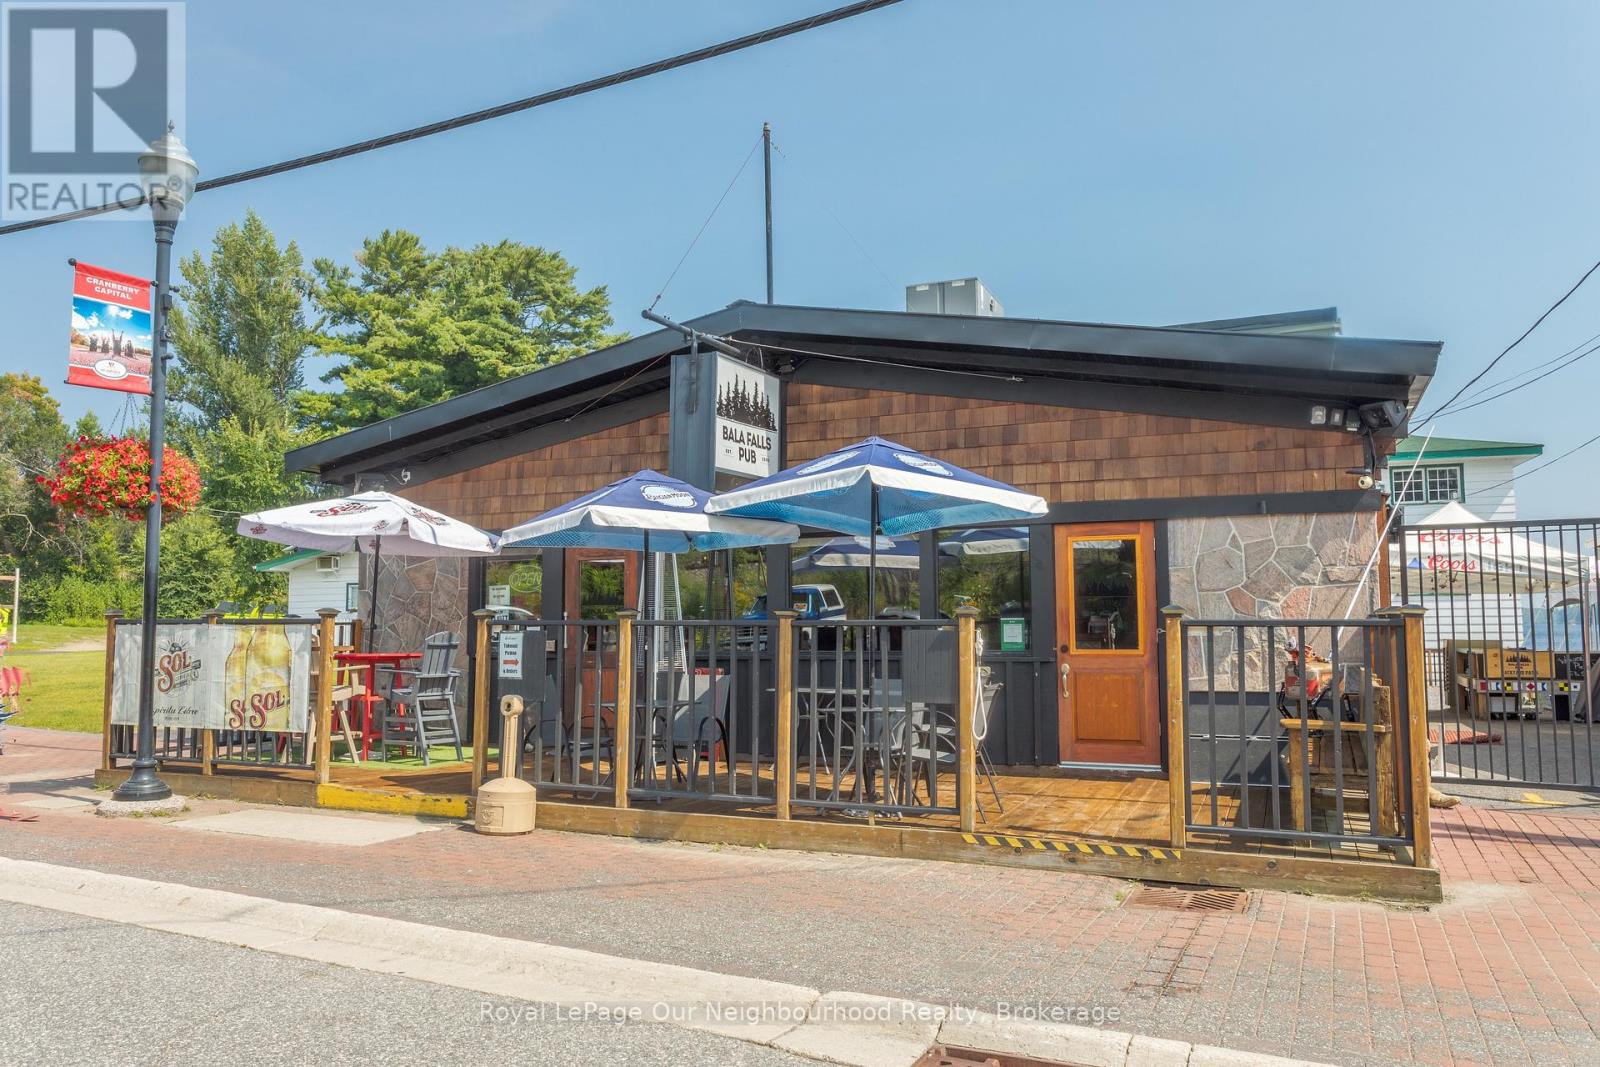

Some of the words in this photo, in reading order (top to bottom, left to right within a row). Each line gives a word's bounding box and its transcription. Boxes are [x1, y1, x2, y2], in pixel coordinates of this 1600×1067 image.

[86, 276, 140, 295] CRANBERRY
[94, 286, 133, 300] CAPITAL
[722, 425, 745, 446] BALA
[746, 431, 772, 451] FALLS
[738, 447, 757, 464] PUB
[1427, 555, 1476, 572] Coors
[157, 650, 192, 693] SOL
[228, 698, 246, 730] S
[249, 688, 286, 730] SOL
